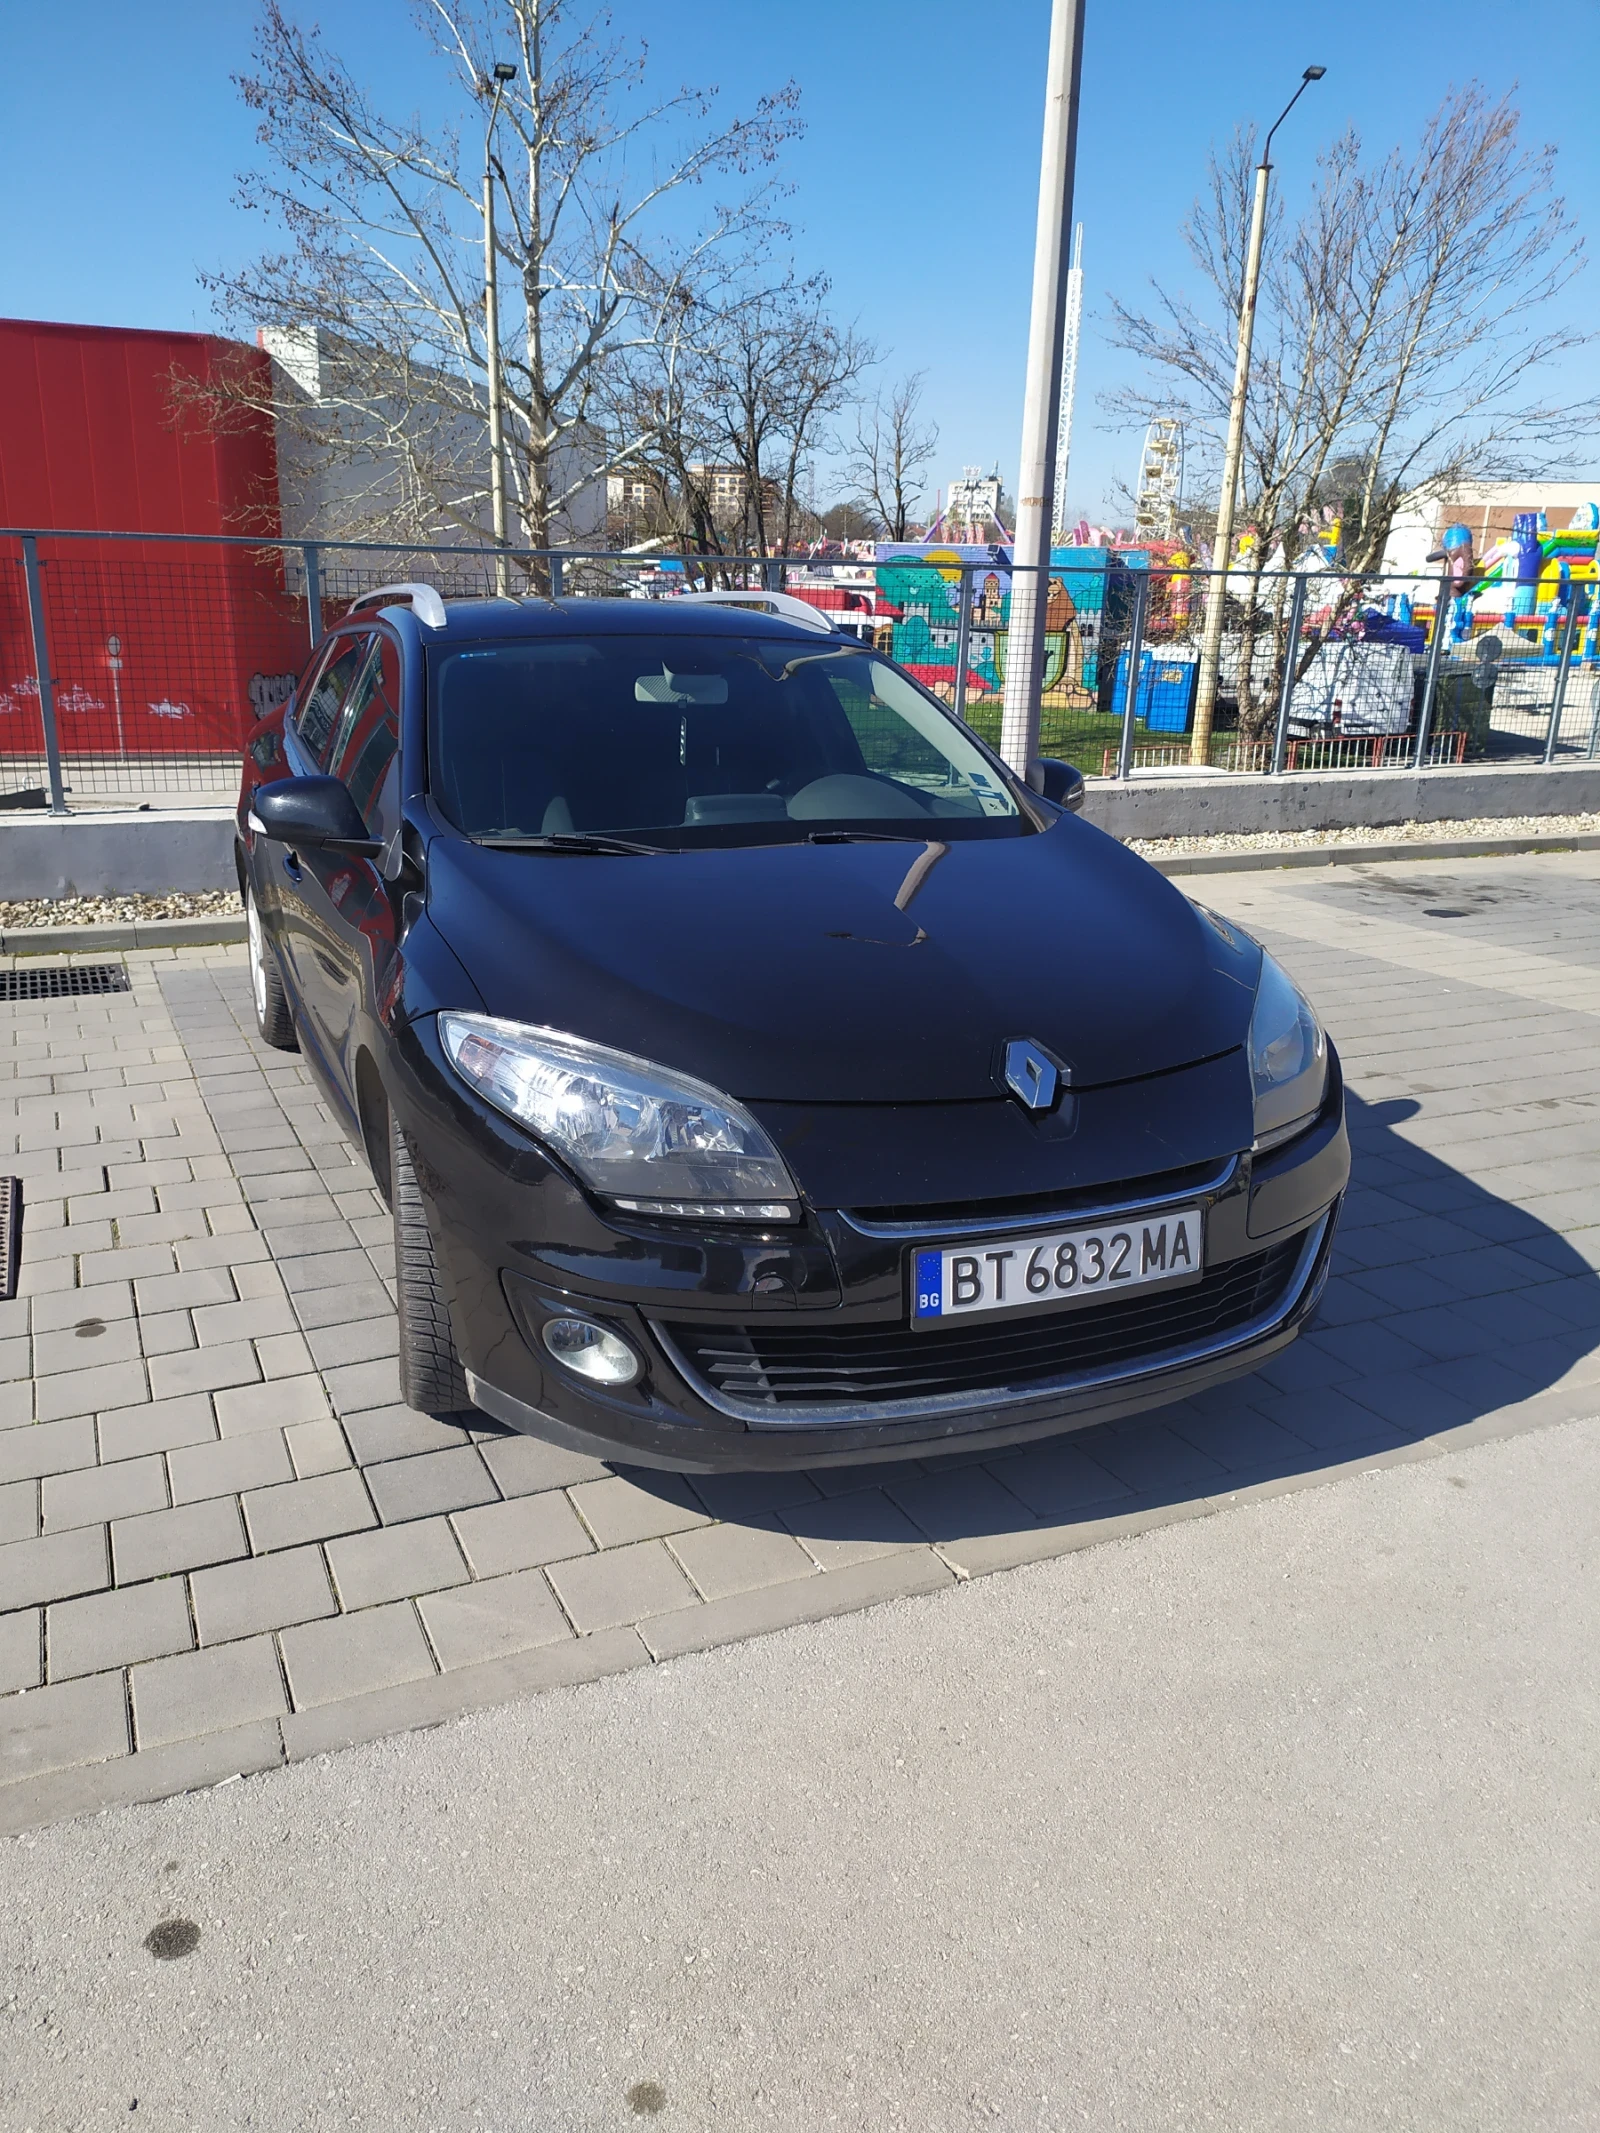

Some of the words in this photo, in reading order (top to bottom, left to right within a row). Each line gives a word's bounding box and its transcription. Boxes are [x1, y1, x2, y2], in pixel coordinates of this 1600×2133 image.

[951, 1249, 1014, 1307] BT
[1025, 1232, 1132, 1294] 6832
[1141, 1220, 1192, 1276] MA
[919, 1293, 940, 1309] BG
